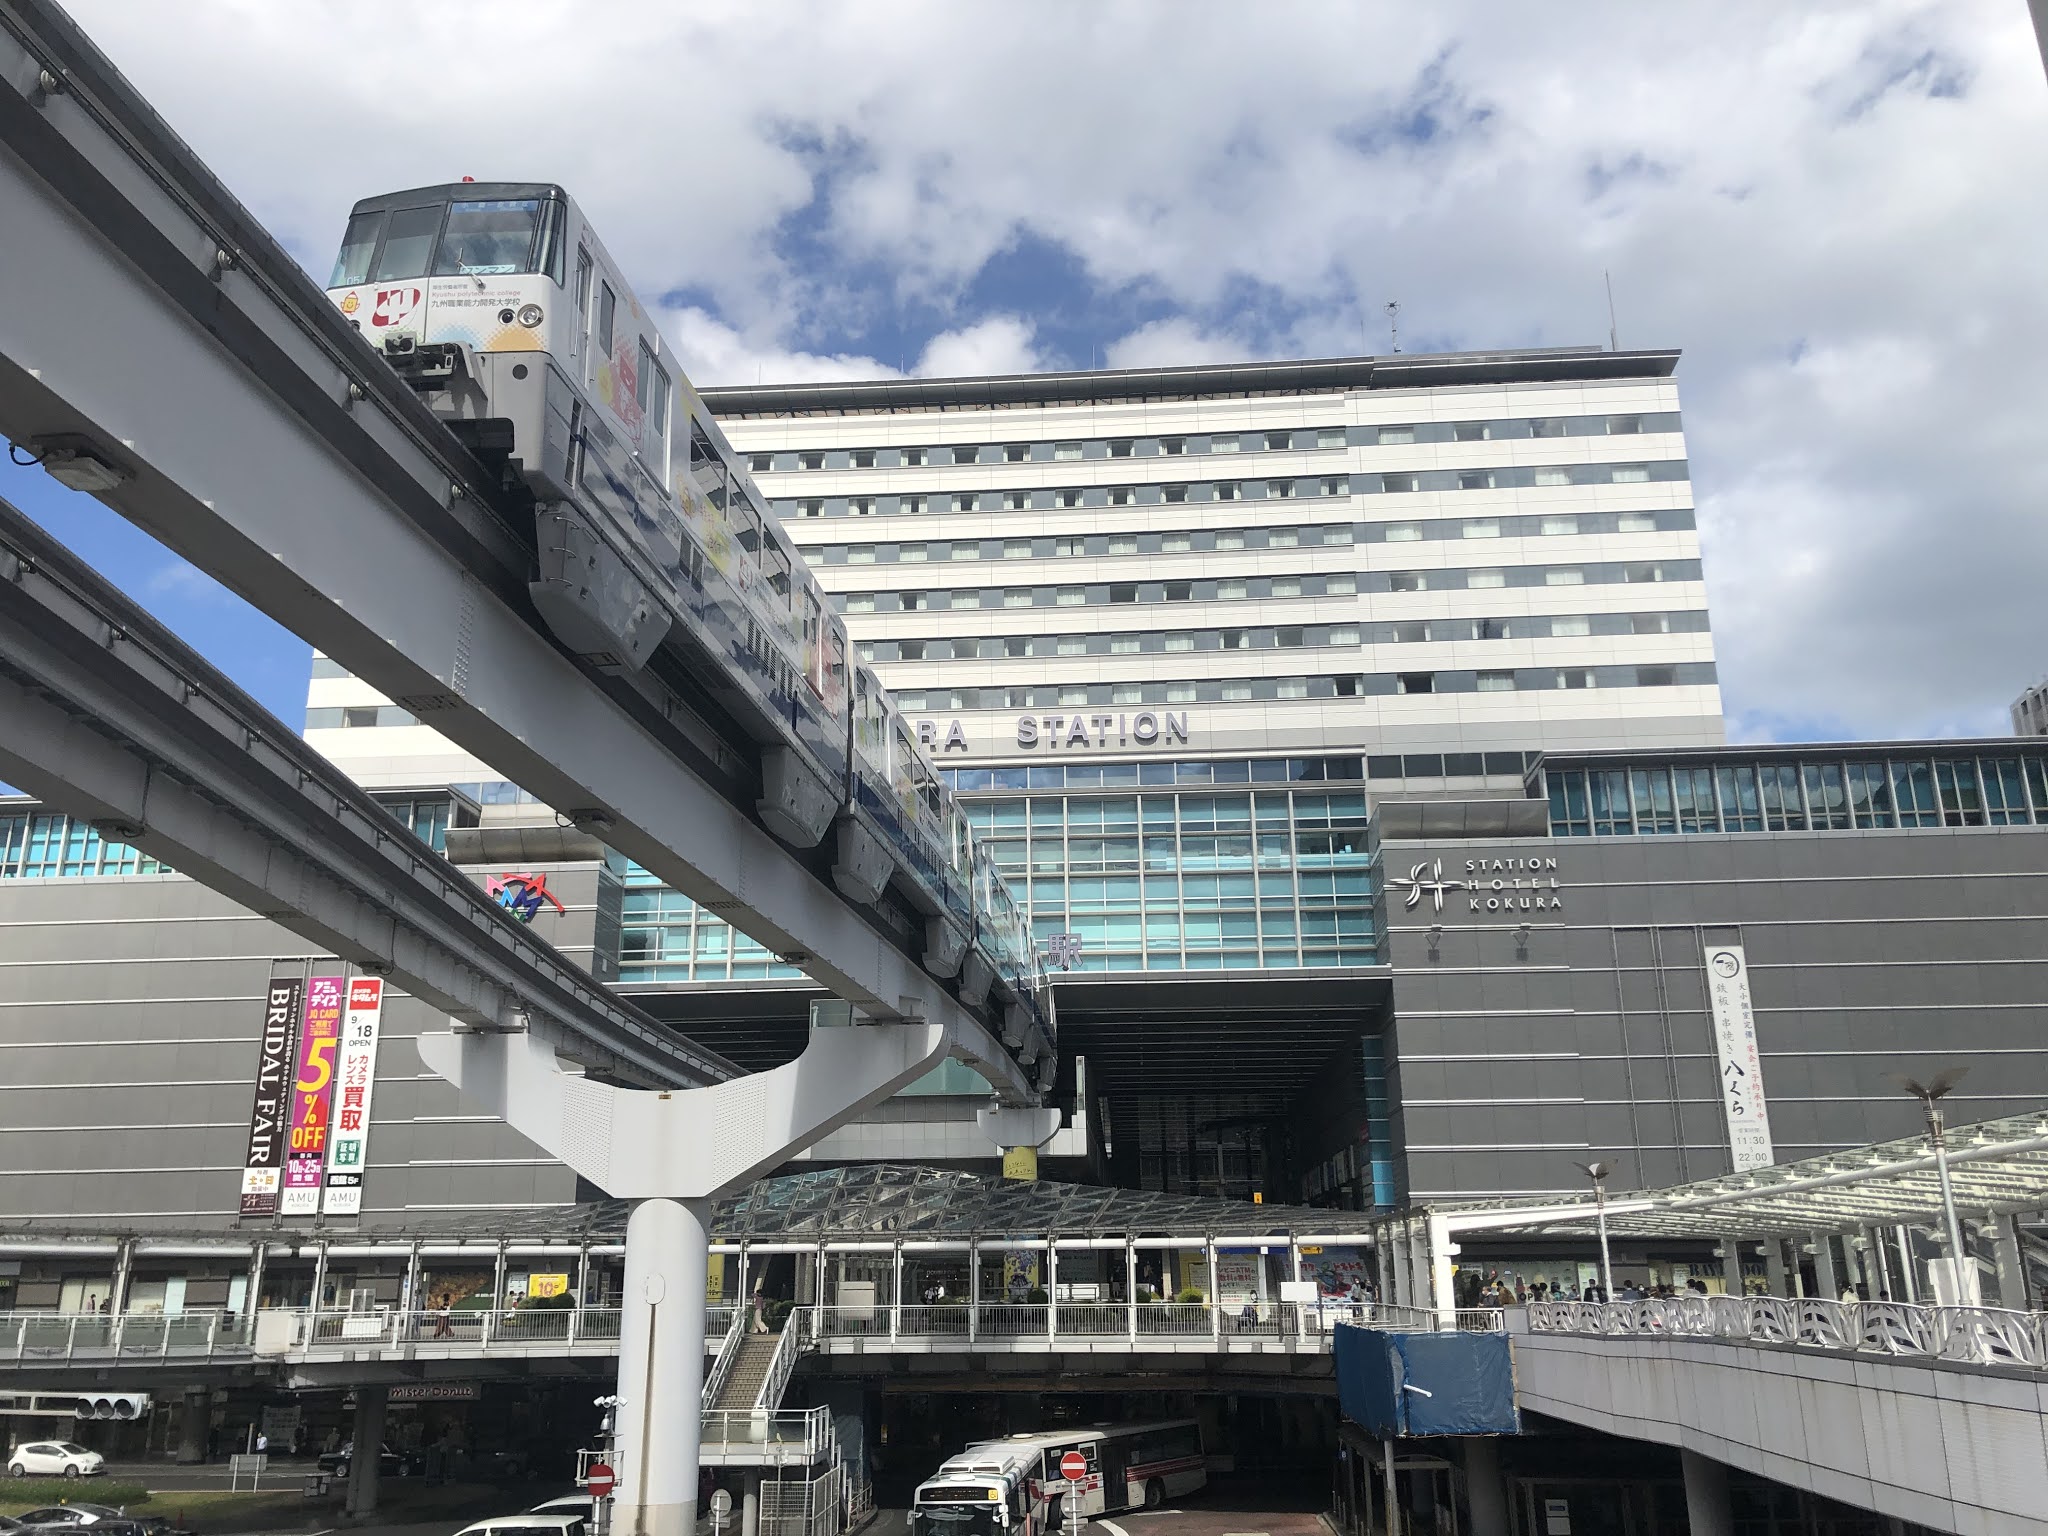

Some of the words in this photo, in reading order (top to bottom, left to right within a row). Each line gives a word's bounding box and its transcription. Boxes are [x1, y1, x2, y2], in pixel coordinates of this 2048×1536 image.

[1017, 711, 1189, 744] STATION
[1465, 858, 1557, 871] STATION
[1468, 878, 1559, 890] HOTEL
[1469, 897, 1561, 909] KOKURA
[1048, 933, 1083, 968] 駅
[314, 981, 337, 993] アミュ
[311, 993, 341, 1007] デイズ
[351, 993, 378, 1002] キタムラ
[320, 1009, 339, 1019] CARD
[1716, 983, 1735, 1055] 鉄板・串焼き
[259, 987, 290, 1091] BRIDAL
[296, 1037, 337, 1092] 5
[345, 1055, 357, 1085] レンズ
[358, 1055, 369, 1085] カメラ
[1724, 1060, 1746, 1116] 八くら
[303, 1094, 318, 1124] %
[340, 1086, 365, 1132] 買取
[249, 1099, 276, 1166] FAIR
[291, 1127, 325, 1149] OFF
[1737, 1136, 1765, 1145] 11:30
[1738, 1153, 1768, 1162] 22:00
[248, 1175, 275, 1185] 土・日
[288, 1193, 316, 1203] AMU
[329, 1193, 356, 1203] AMU
